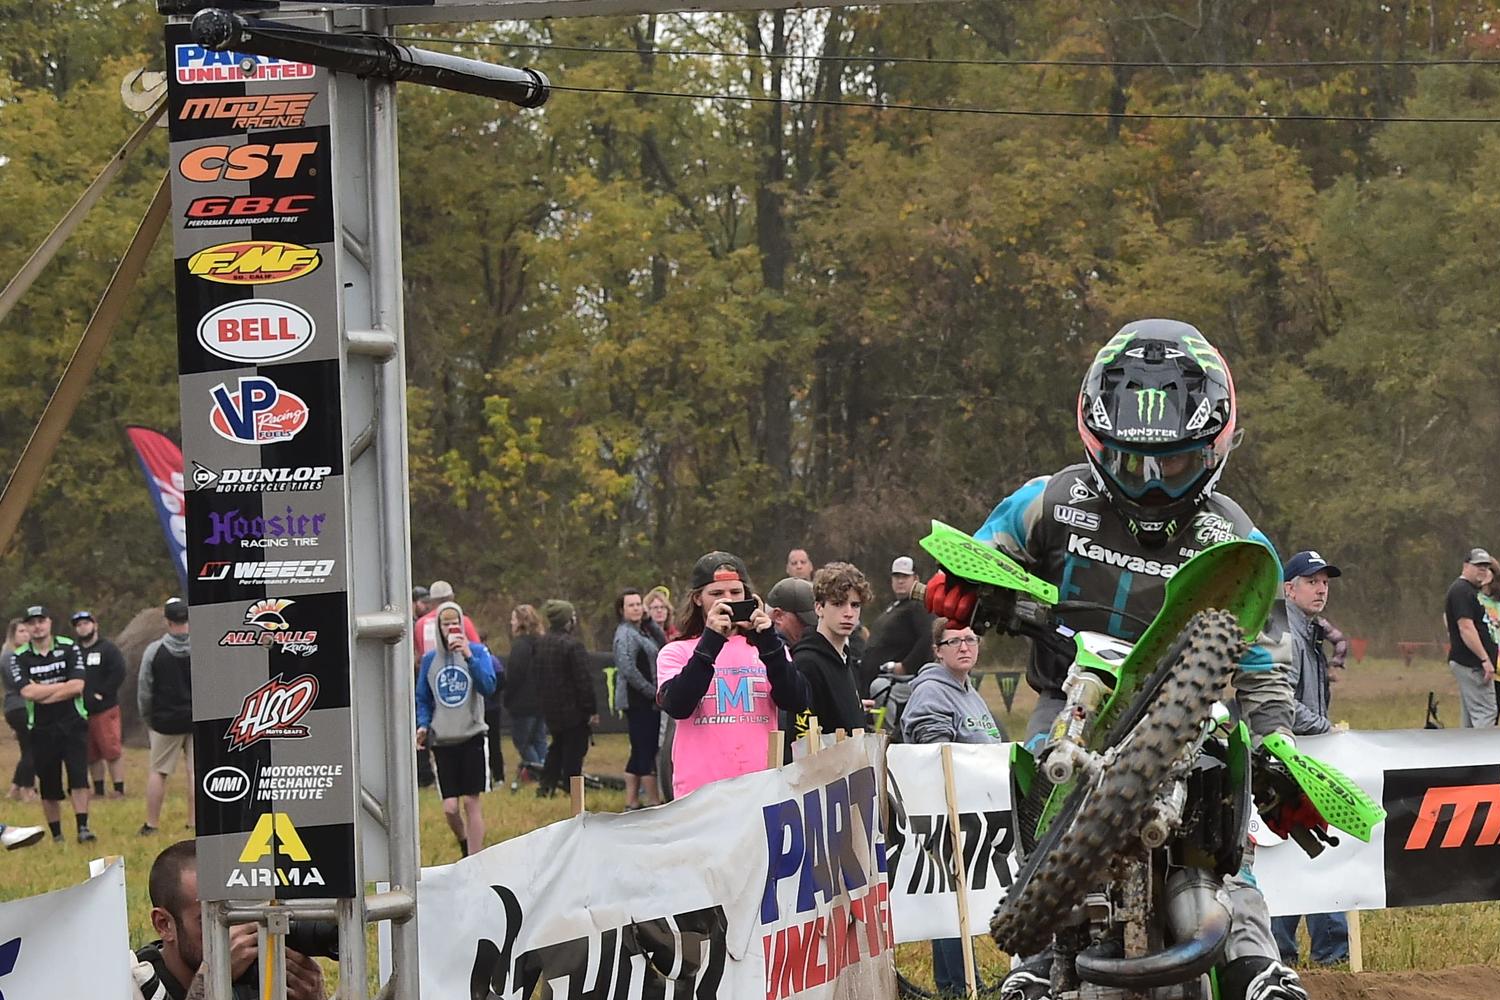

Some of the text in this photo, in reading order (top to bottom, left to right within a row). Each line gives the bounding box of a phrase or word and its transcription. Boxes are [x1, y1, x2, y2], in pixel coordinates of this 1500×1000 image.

[179, 92, 317, 120] MOOSE
[232, 115, 304, 129] RACING
[180, 142, 318, 182] CST
[187, 195, 316, 217] GBC
[188, 218, 233, 227] PERFORMANCE
[234, 216, 280, 225] MOTORSPORTS
[190, 246, 318, 275] FMF
[218, 317, 296, 342] BELL
[213, 380, 277, 440] VP
[258, 408, 309, 431] Racing
[259, 430, 292, 438] FUELS
[1117, 428, 1178, 438] MONSTER
[219, 466, 332, 484] DUNLOP
[216, 482, 322, 493] MOTORCYCLE TIRES
[204, 505, 327, 545] Hoosier
[1054, 504, 1101, 531] WPS
[1194, 511, 1233, 532] TEAM
[240, 538, 319, 548] RACING TIRE
[1068, 534, 1182, 579] Kawasa
[219, 632, 256, 645] ALL
[281, 642, 318, 656] Racing
[694, 716, 736, 725] RACING
[260, 765, 343, 778] MOTORCYCLE
[210, 777, 243, 792] MMI
[258, 777, 334, 789] MECHANICS
[257, 789, 324, 800] INSTITUTE
[760, 766, 886, 925] PART
[226, 868, 326, 887] ARMA
